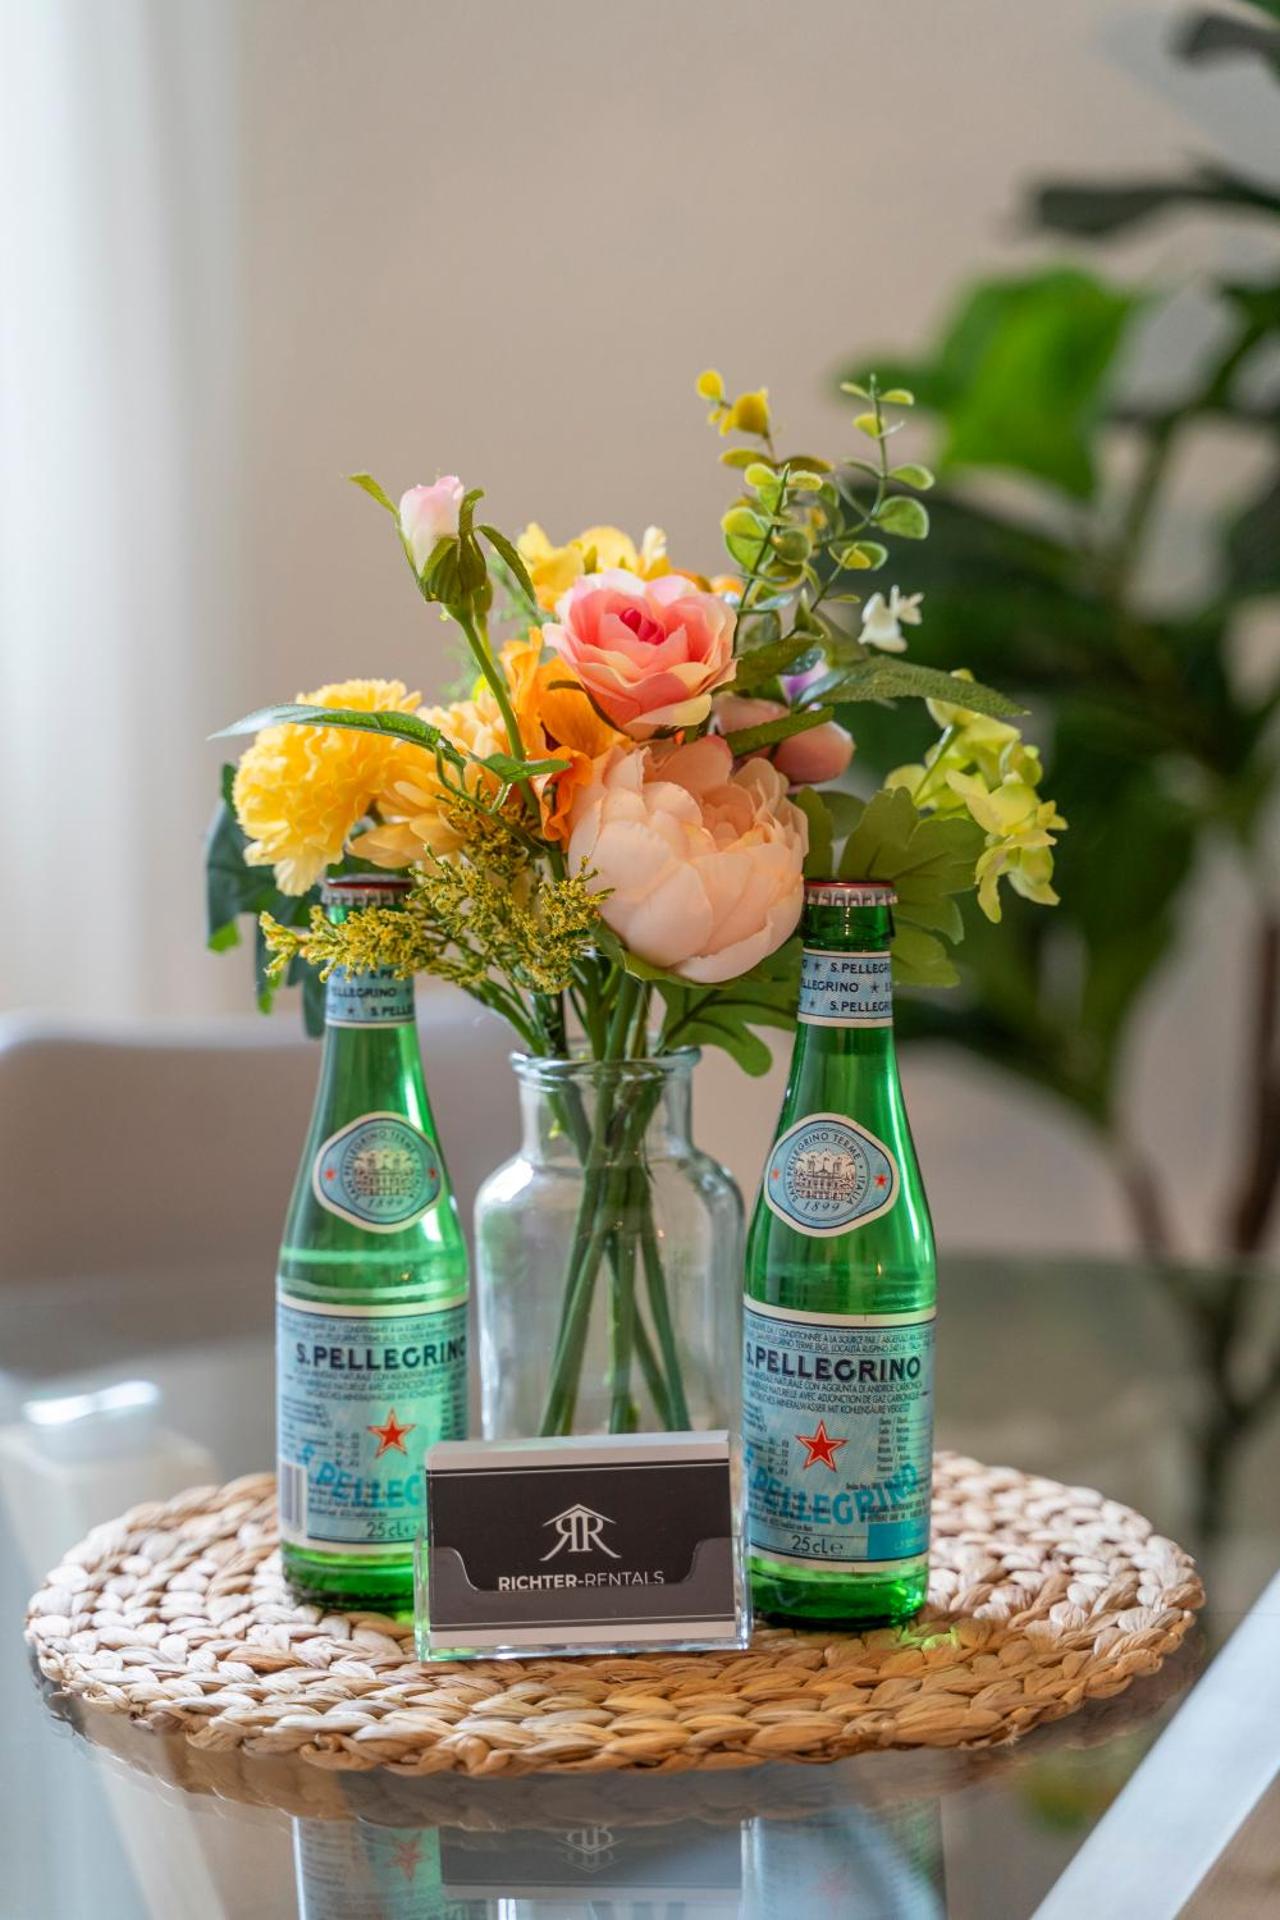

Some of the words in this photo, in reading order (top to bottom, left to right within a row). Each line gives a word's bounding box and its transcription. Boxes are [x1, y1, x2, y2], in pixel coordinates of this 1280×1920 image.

[833, 1134, 862, 1160] TERME
[802, 1201, 841, 1212] 1899
[745, 1341, 922, 1382] S.PELLEGRINO
[498, 1570, 665, 1592] RICHTER-RENTALS
